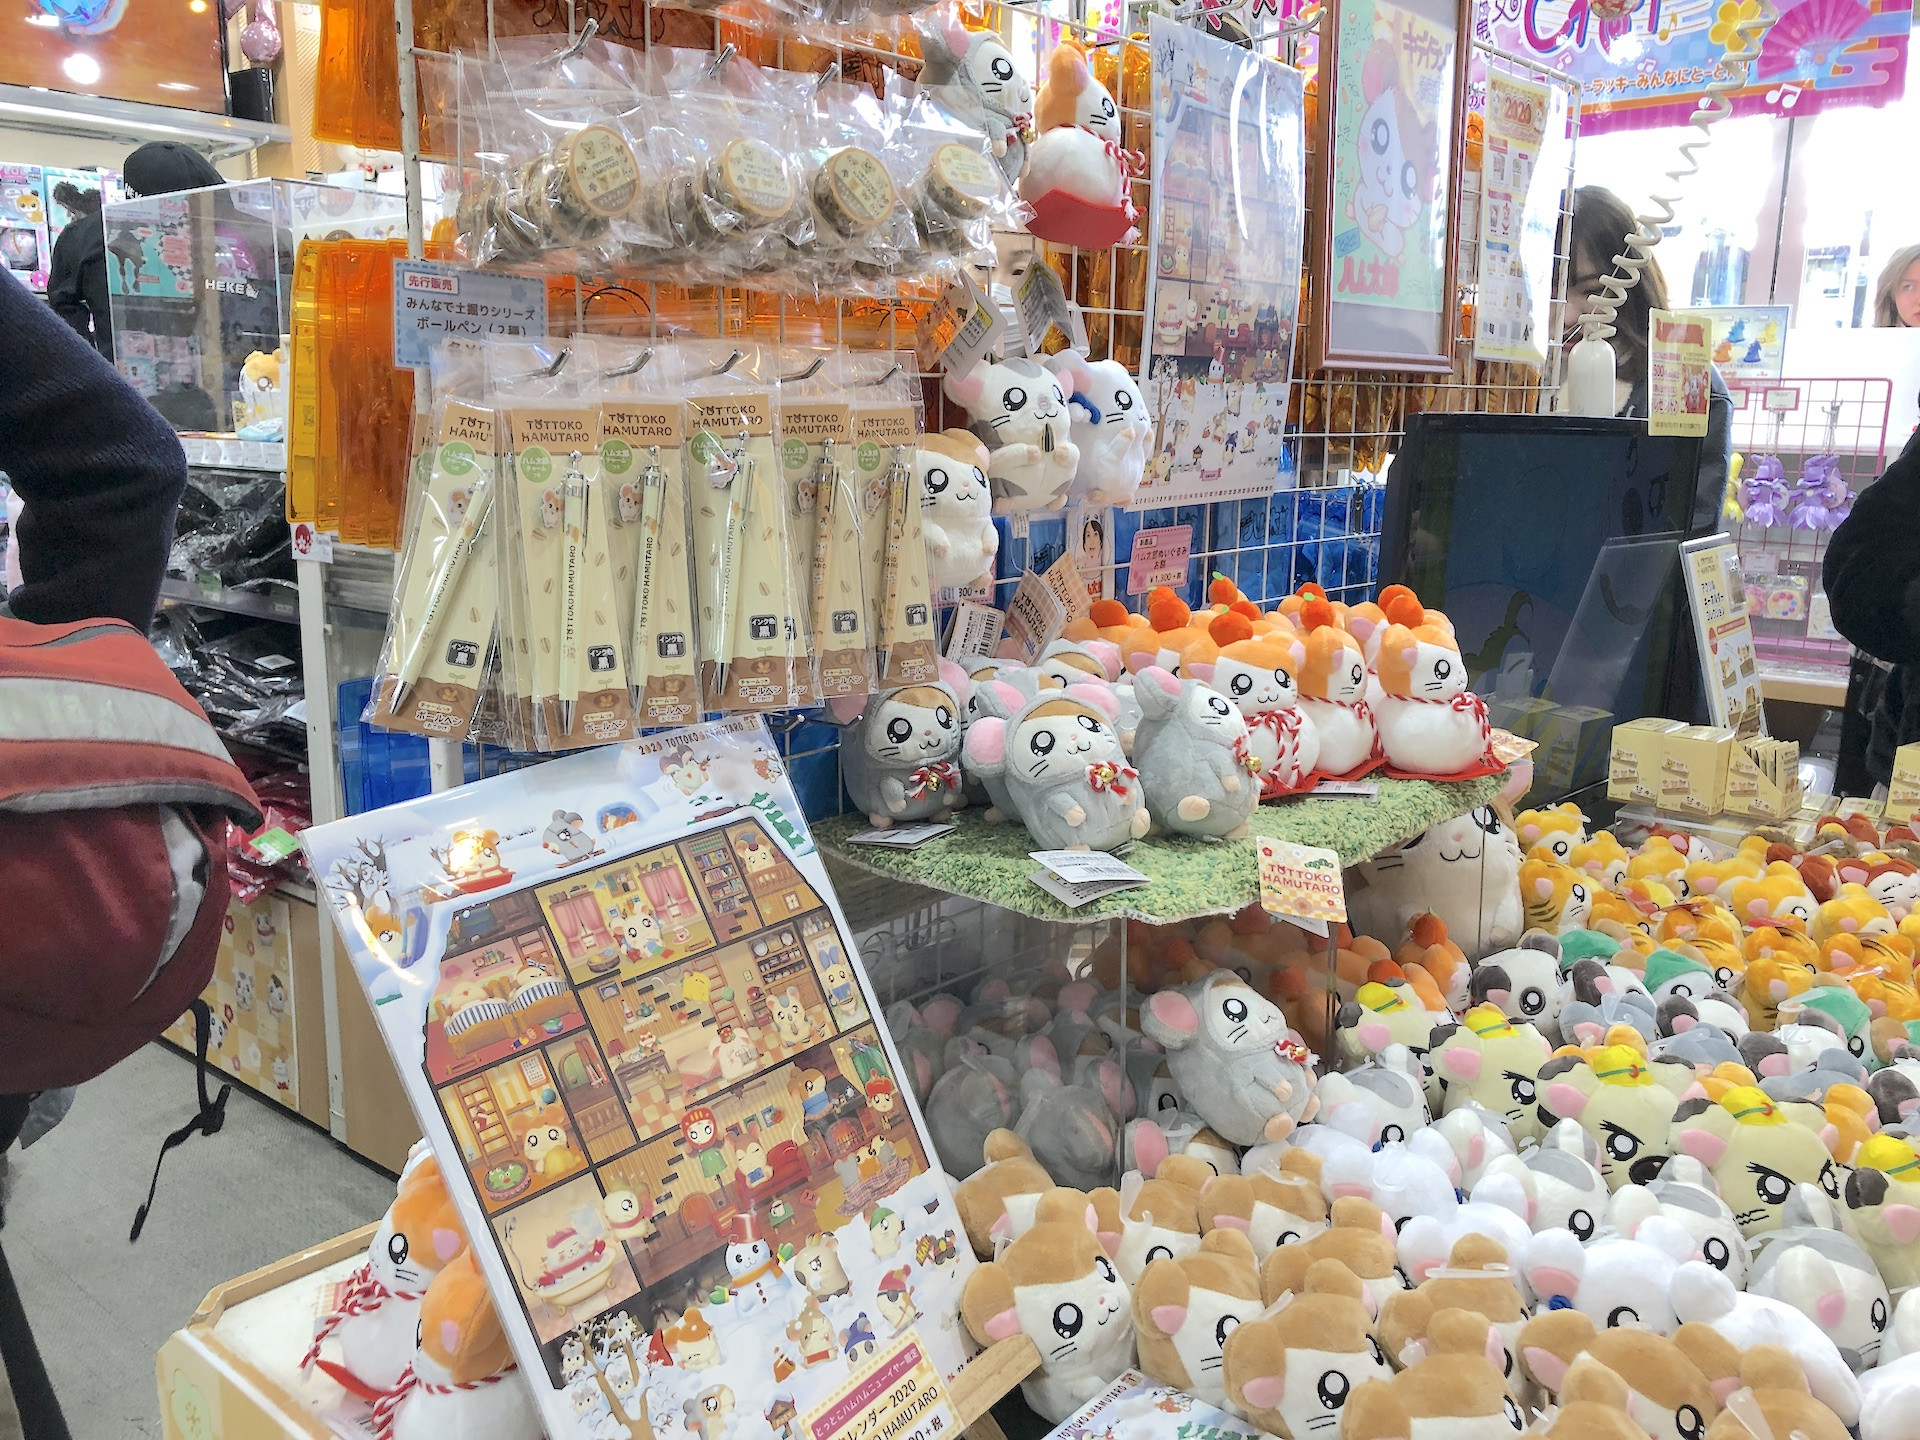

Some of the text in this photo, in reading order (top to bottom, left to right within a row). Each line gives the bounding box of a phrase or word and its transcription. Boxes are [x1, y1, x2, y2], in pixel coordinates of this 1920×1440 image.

[1504, 95, 1532, 124] 2020
[408, 275, 453, 291] 先行販売
[406, 297, 536, 321] みんなで土掘りシリーズ
[608, 412, 667, 424] TOTTOKO
[699, 404, 756, 416] TOTTOKO
[527, 419, 583, 430] TOTTOKO
[693, 415, 763, 429] HAMUTARO
[786, 413, 838, 424] TOTTOKO
[862, 418, 906, 428] TOTTOKO
[522, 432, 590, 443] HAMUTARO
[603, 425, 673, 437] HAMUTARO
[783, 424, 844, 435] HAMUTARO
[858, 427, 910, 438] HAMUTARO
[1021, 591, 1047, 632] TOTTOKO
[1013, 596, 1044, 645] HAMUTARO
[665, 732, 699, 748] TOTTOKO
[1268, 863, 1332, 883] TOTTOKO
[1262, 873, 1340, 895] HAMUTARO
[815, 1349, 921, 1438] とっとこハムハムニューイヤー限定
[889, 1379, 917, 1408] 2020
[882, 1387, 938, 1440] HAMUTARO
[1057, 1415, 1090, 1440] TOTTOKO
[1093, 1384, 1127, 1415] HAMUTARO
